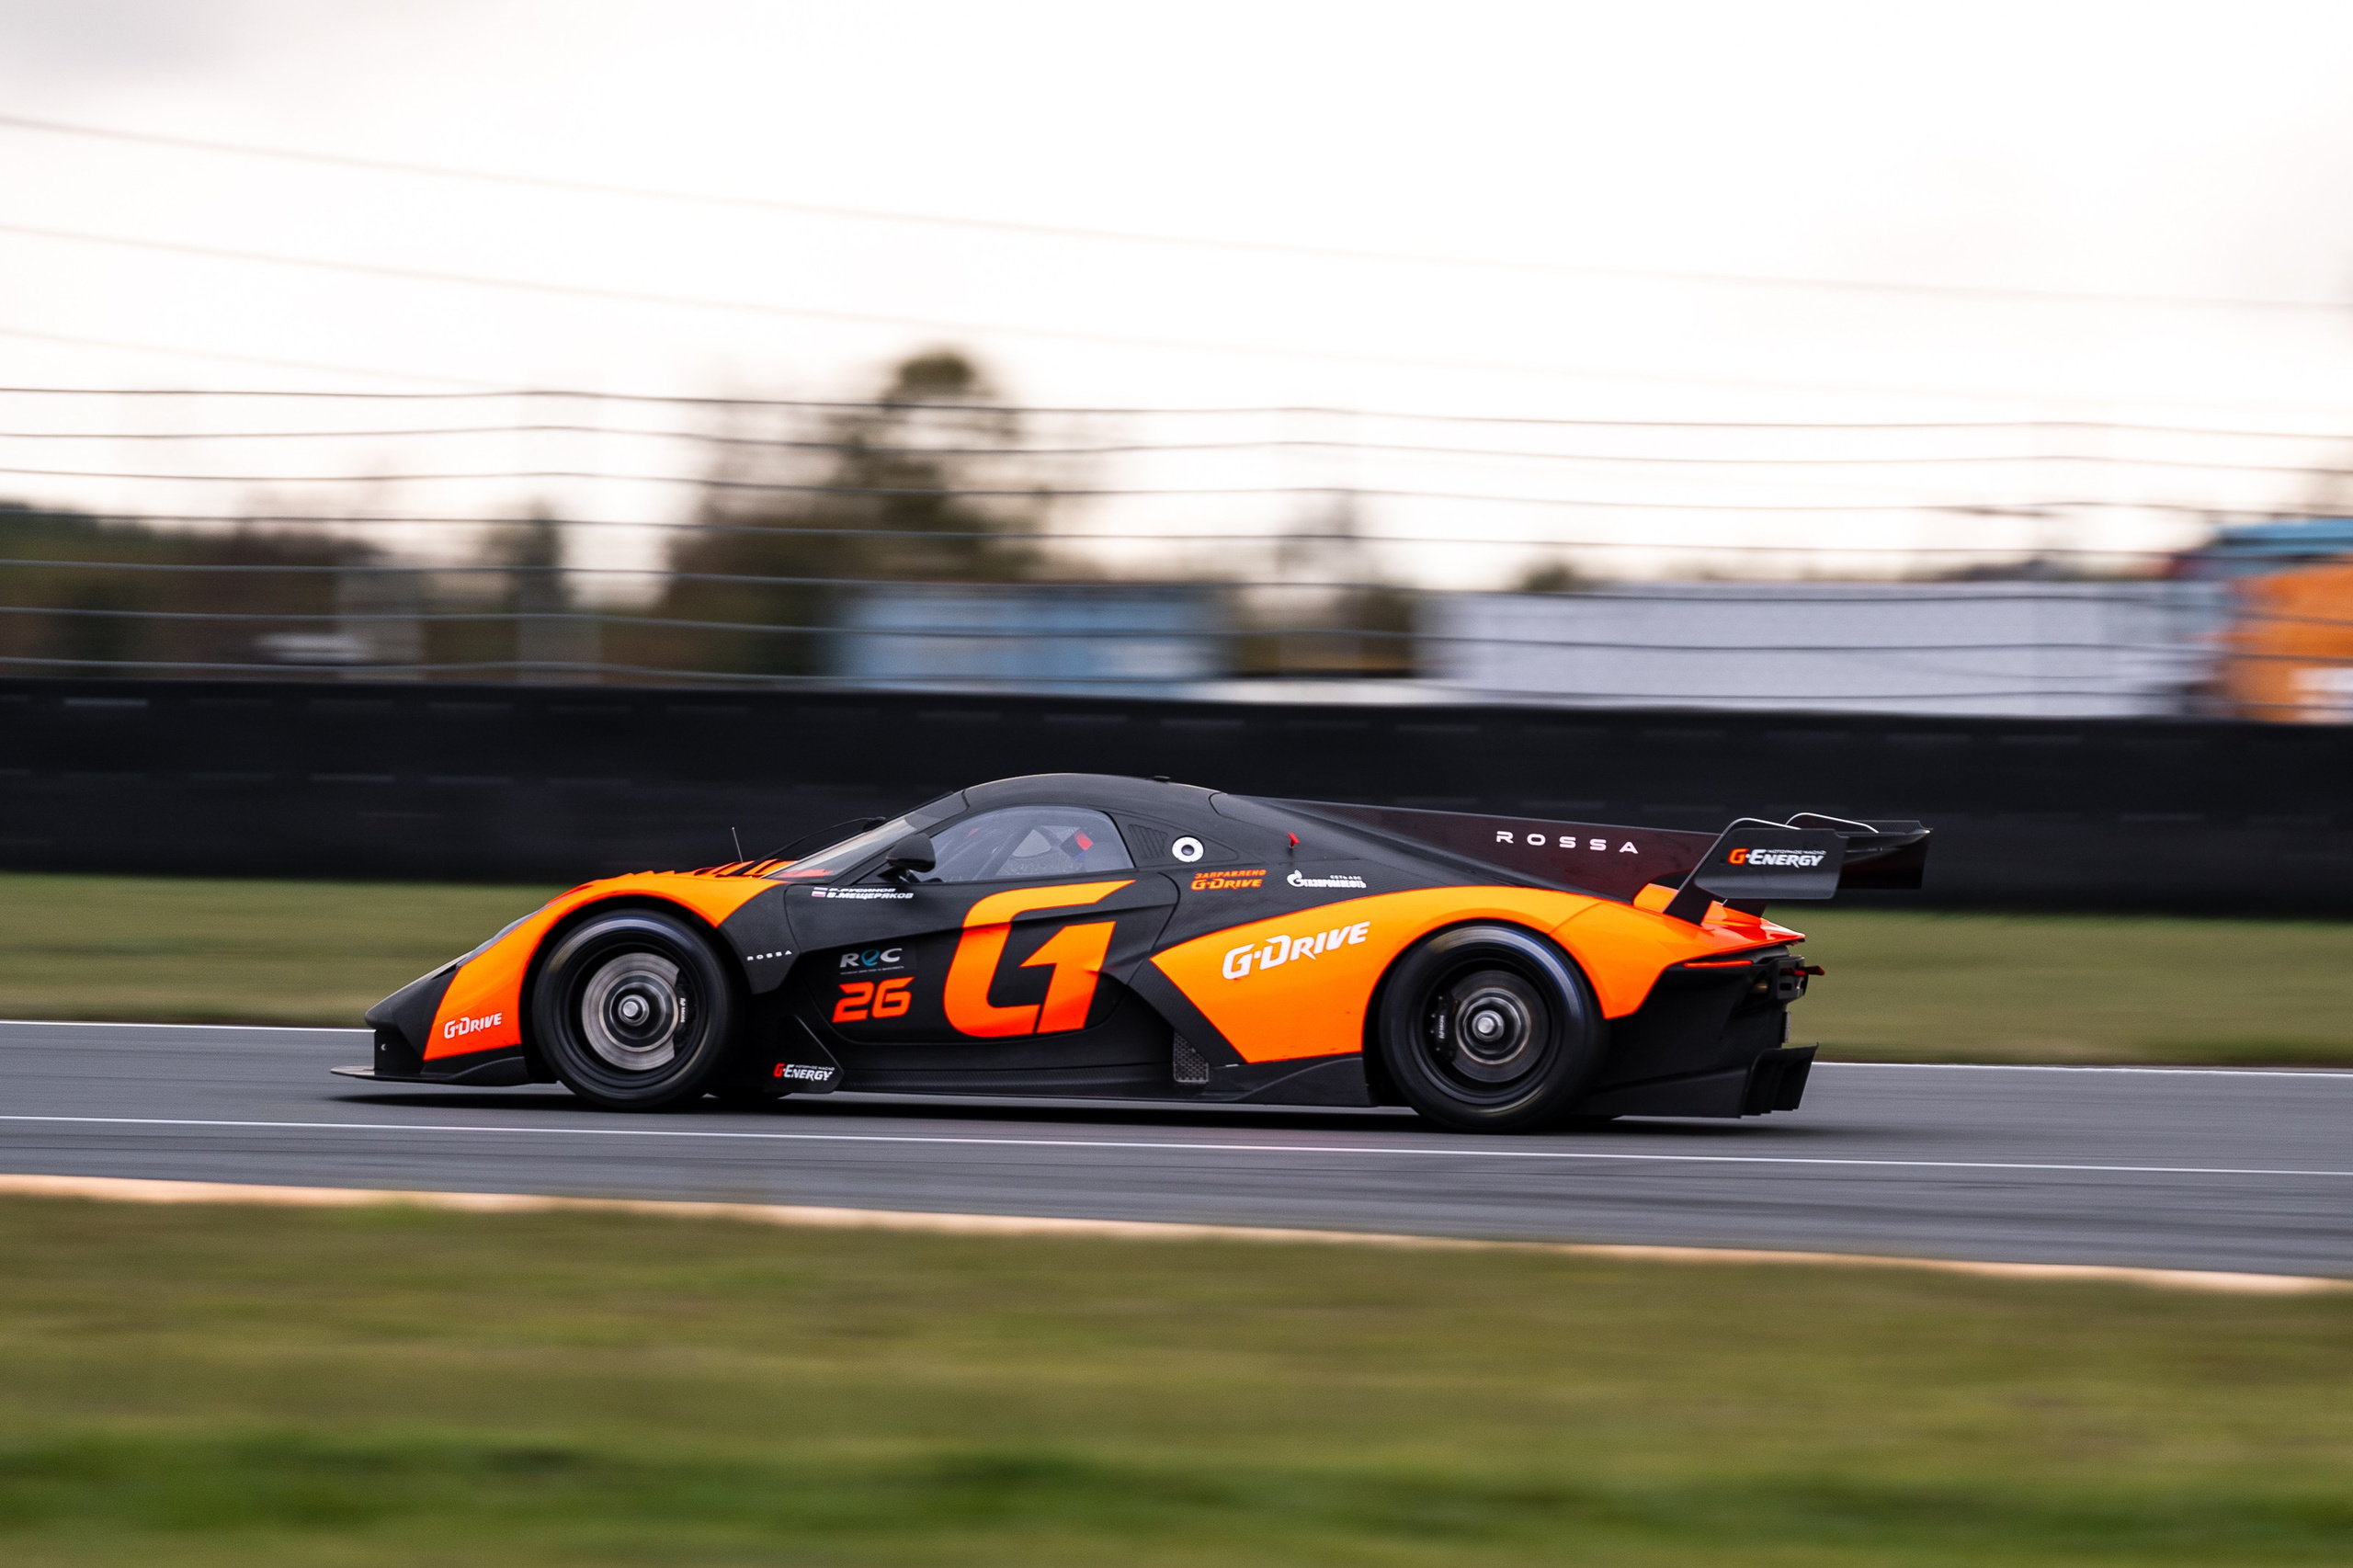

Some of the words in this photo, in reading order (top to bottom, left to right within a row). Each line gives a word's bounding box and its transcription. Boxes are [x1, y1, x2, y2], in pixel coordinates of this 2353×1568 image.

[1495, 830, 1639, 855] ROSSA
[826, 892, 915, 900] В.МЕЩЕРЯКОВ
[1190, 878, 1263, 890] G-DRIVE
[1222, 921, 1370, 980] G-DRIVE
[832, 976, 915, 1024] 26
[443, 1012, 503, 1040] G-DRIVE
